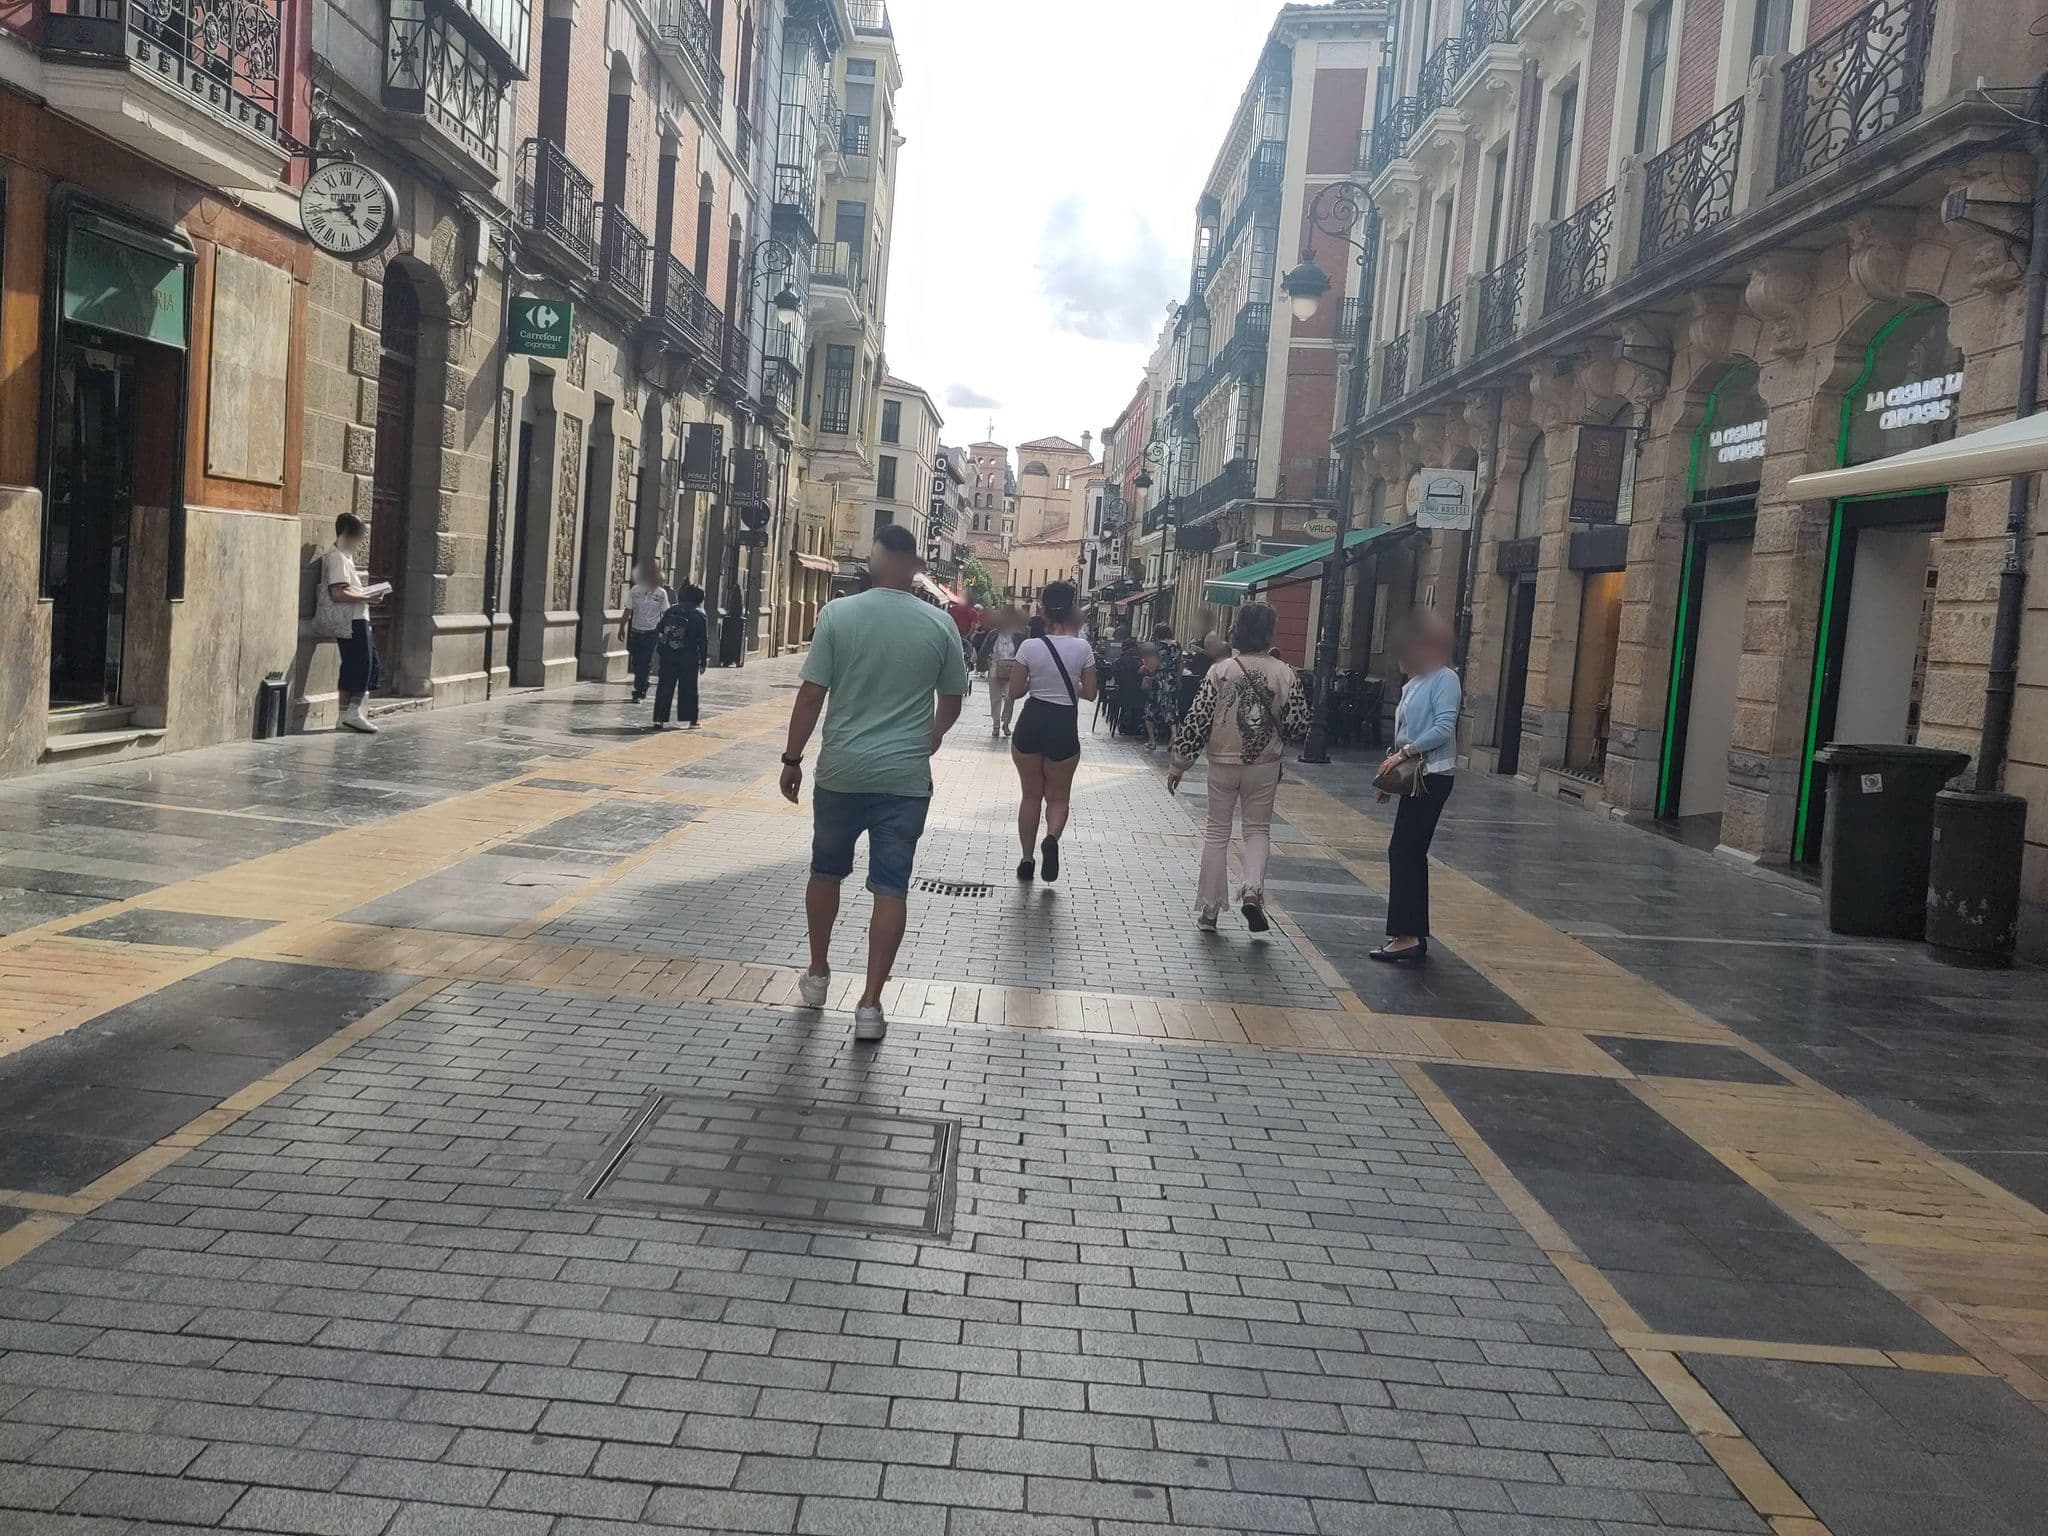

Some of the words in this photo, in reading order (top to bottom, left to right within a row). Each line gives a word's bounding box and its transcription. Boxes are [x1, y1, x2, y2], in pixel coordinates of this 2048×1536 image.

[323, 174, 338, 191] XI
[339, 171, 352, 187] XII
[312, 186, 327, 199] X
[363, 188, 378, 200] II
[367, 205, 382, 214] III
[520, 330, 562, 342] Carrefour
[525, 341, 556, 350] express
[1865, 391, 1885, 412] LA
[1879, 399, 1951, 430] CARCASAS
[711, 428, 722, 491] OPTICA
[753, 452, 764, 507] OPTICA
